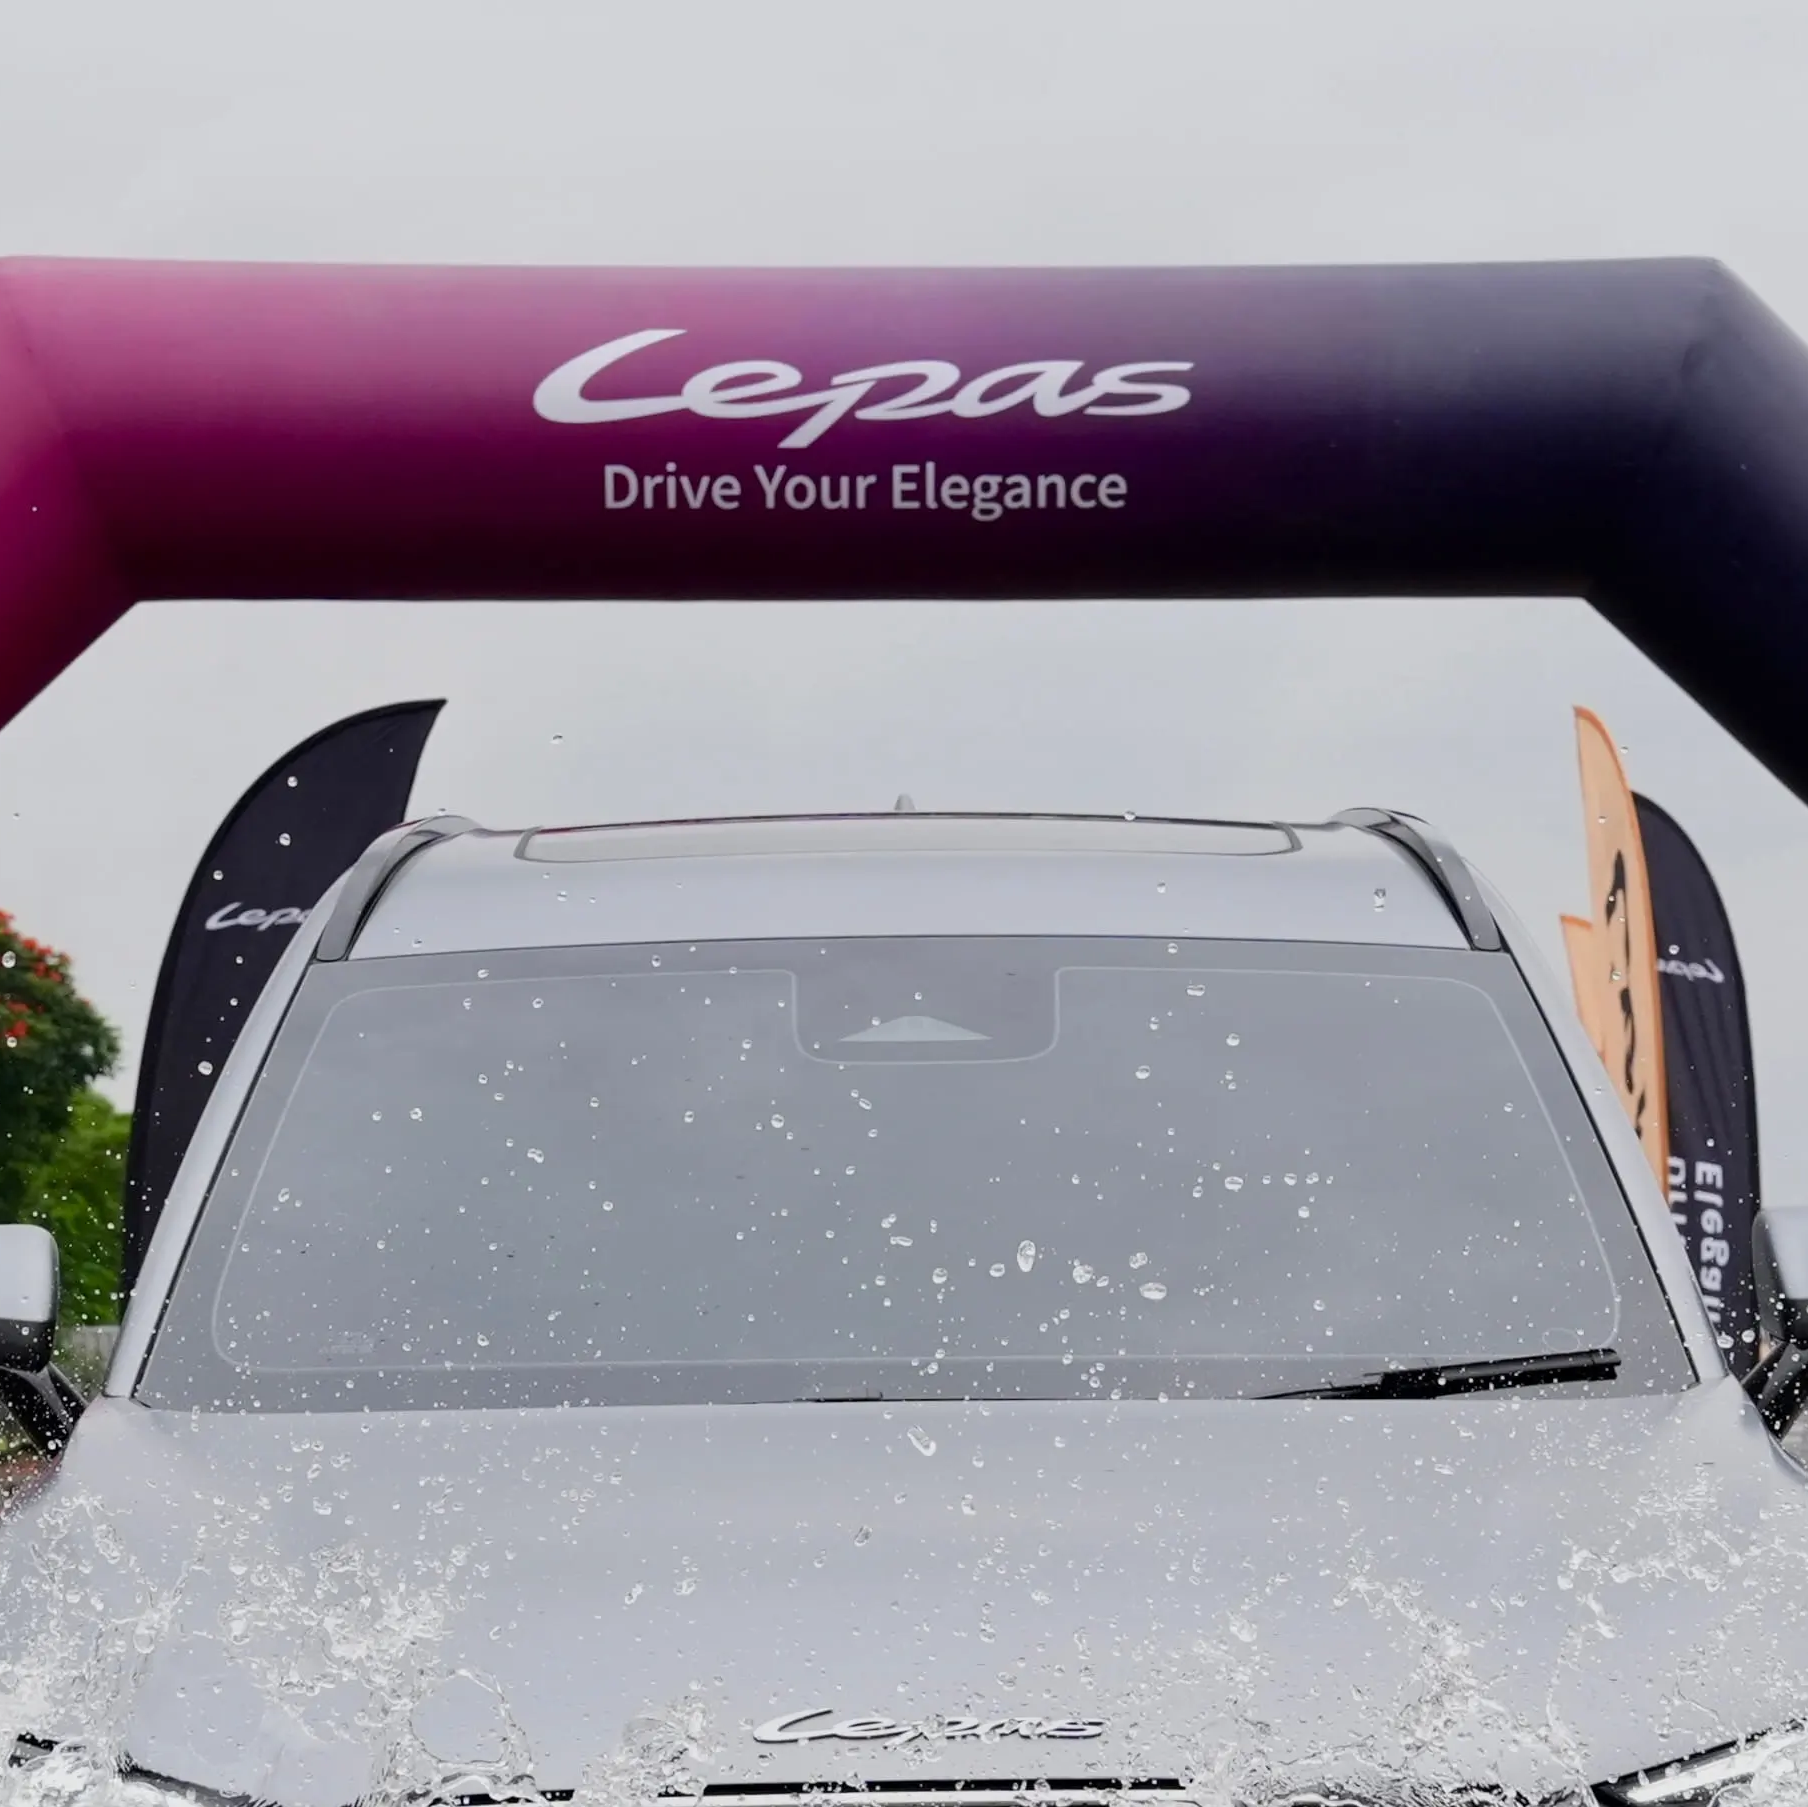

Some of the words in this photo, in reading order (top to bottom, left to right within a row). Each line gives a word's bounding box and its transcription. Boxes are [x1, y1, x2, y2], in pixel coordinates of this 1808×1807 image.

[533, 328, 1194, 449] Lepas
[604, 462, 741, 509] Drive
[753, 465, 876, 510] Your
[892, 461, 1128, 522] Elegance
[753, 1708, 1105, 1751] Lepas
